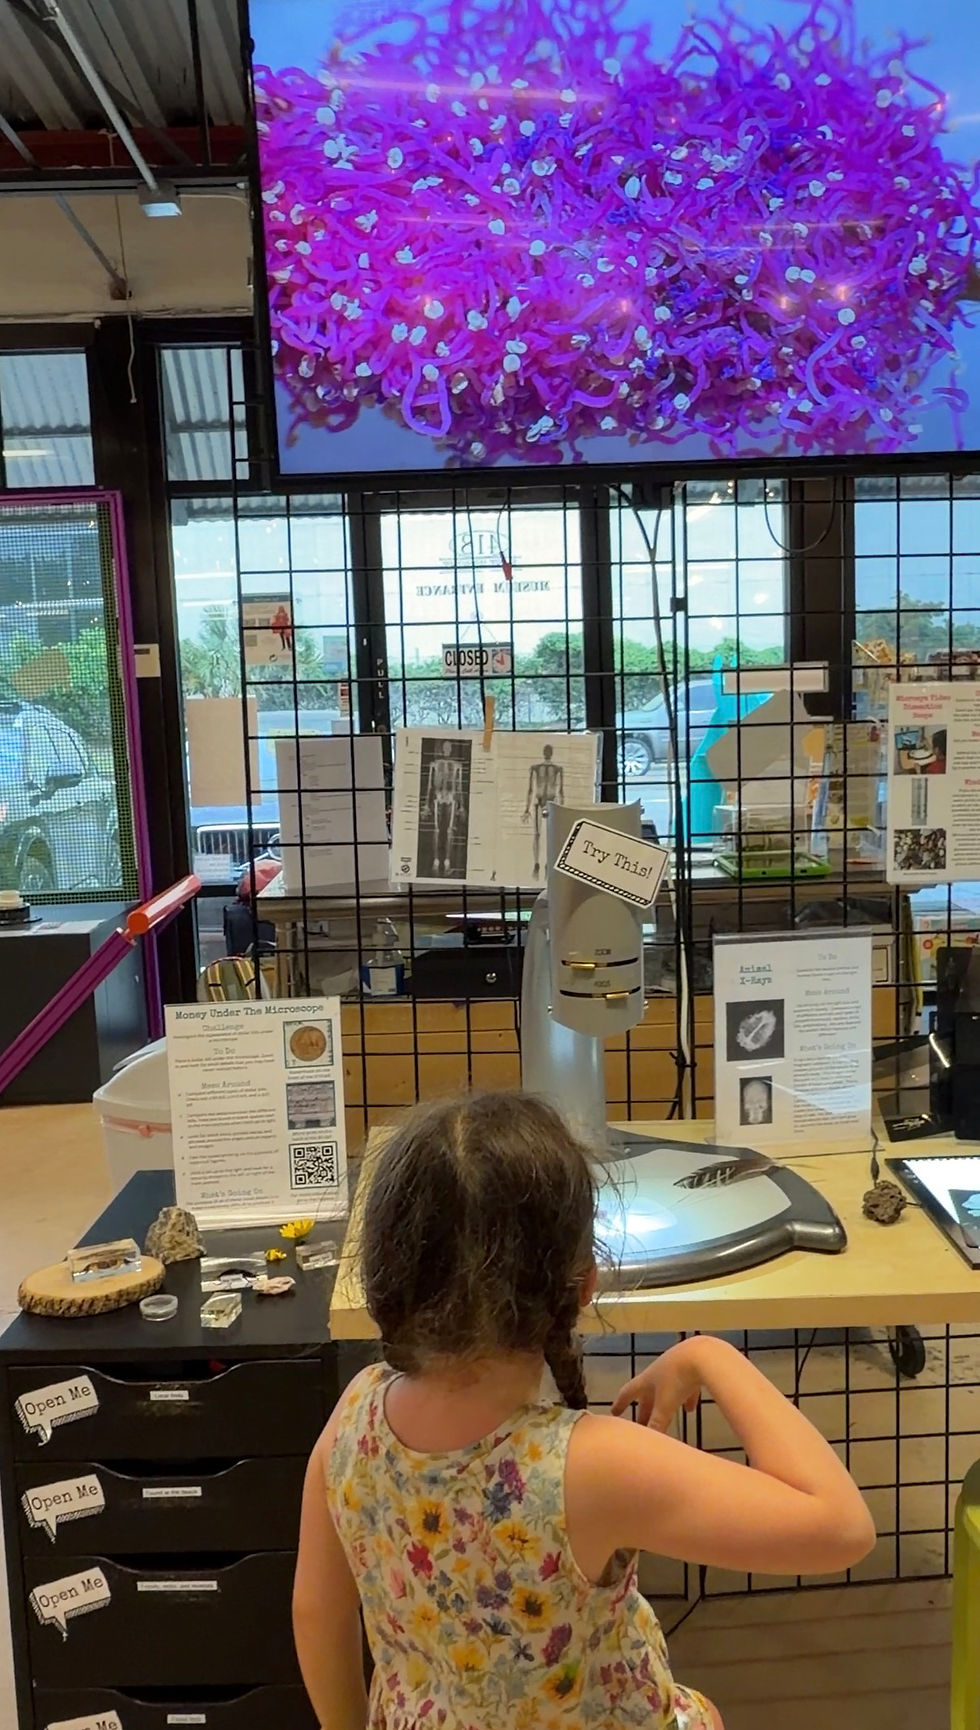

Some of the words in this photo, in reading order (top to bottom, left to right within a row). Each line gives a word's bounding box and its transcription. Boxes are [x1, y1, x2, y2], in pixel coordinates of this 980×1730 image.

[445, 649, 489, 666] CLOSED
[376, 658, 385, 699] PULL
[583, 840, 610, 864] Try
[614, 852, 654, 880] This!
[739, 964, 772, 973] Animal
[739, 976, 773, 986] X-Rays
[175, 1011, 207, 1020] Money
[209, 1008, 241, 1018] Under
[243, 1007, 263, 1016] The
[265, 1004, 324, 1015] Microscope
[25, 1395, 66, 1415] Open
[68, 1384, 92, 1400] Me
[31, 1493, 72, 1511] Open
[76, 1484, 99, 1499] Me
[39, 1588, 79, 1607] Open
[81, 1576, 104, 1592] Me
[96, 1720, 117, 1730] Me
